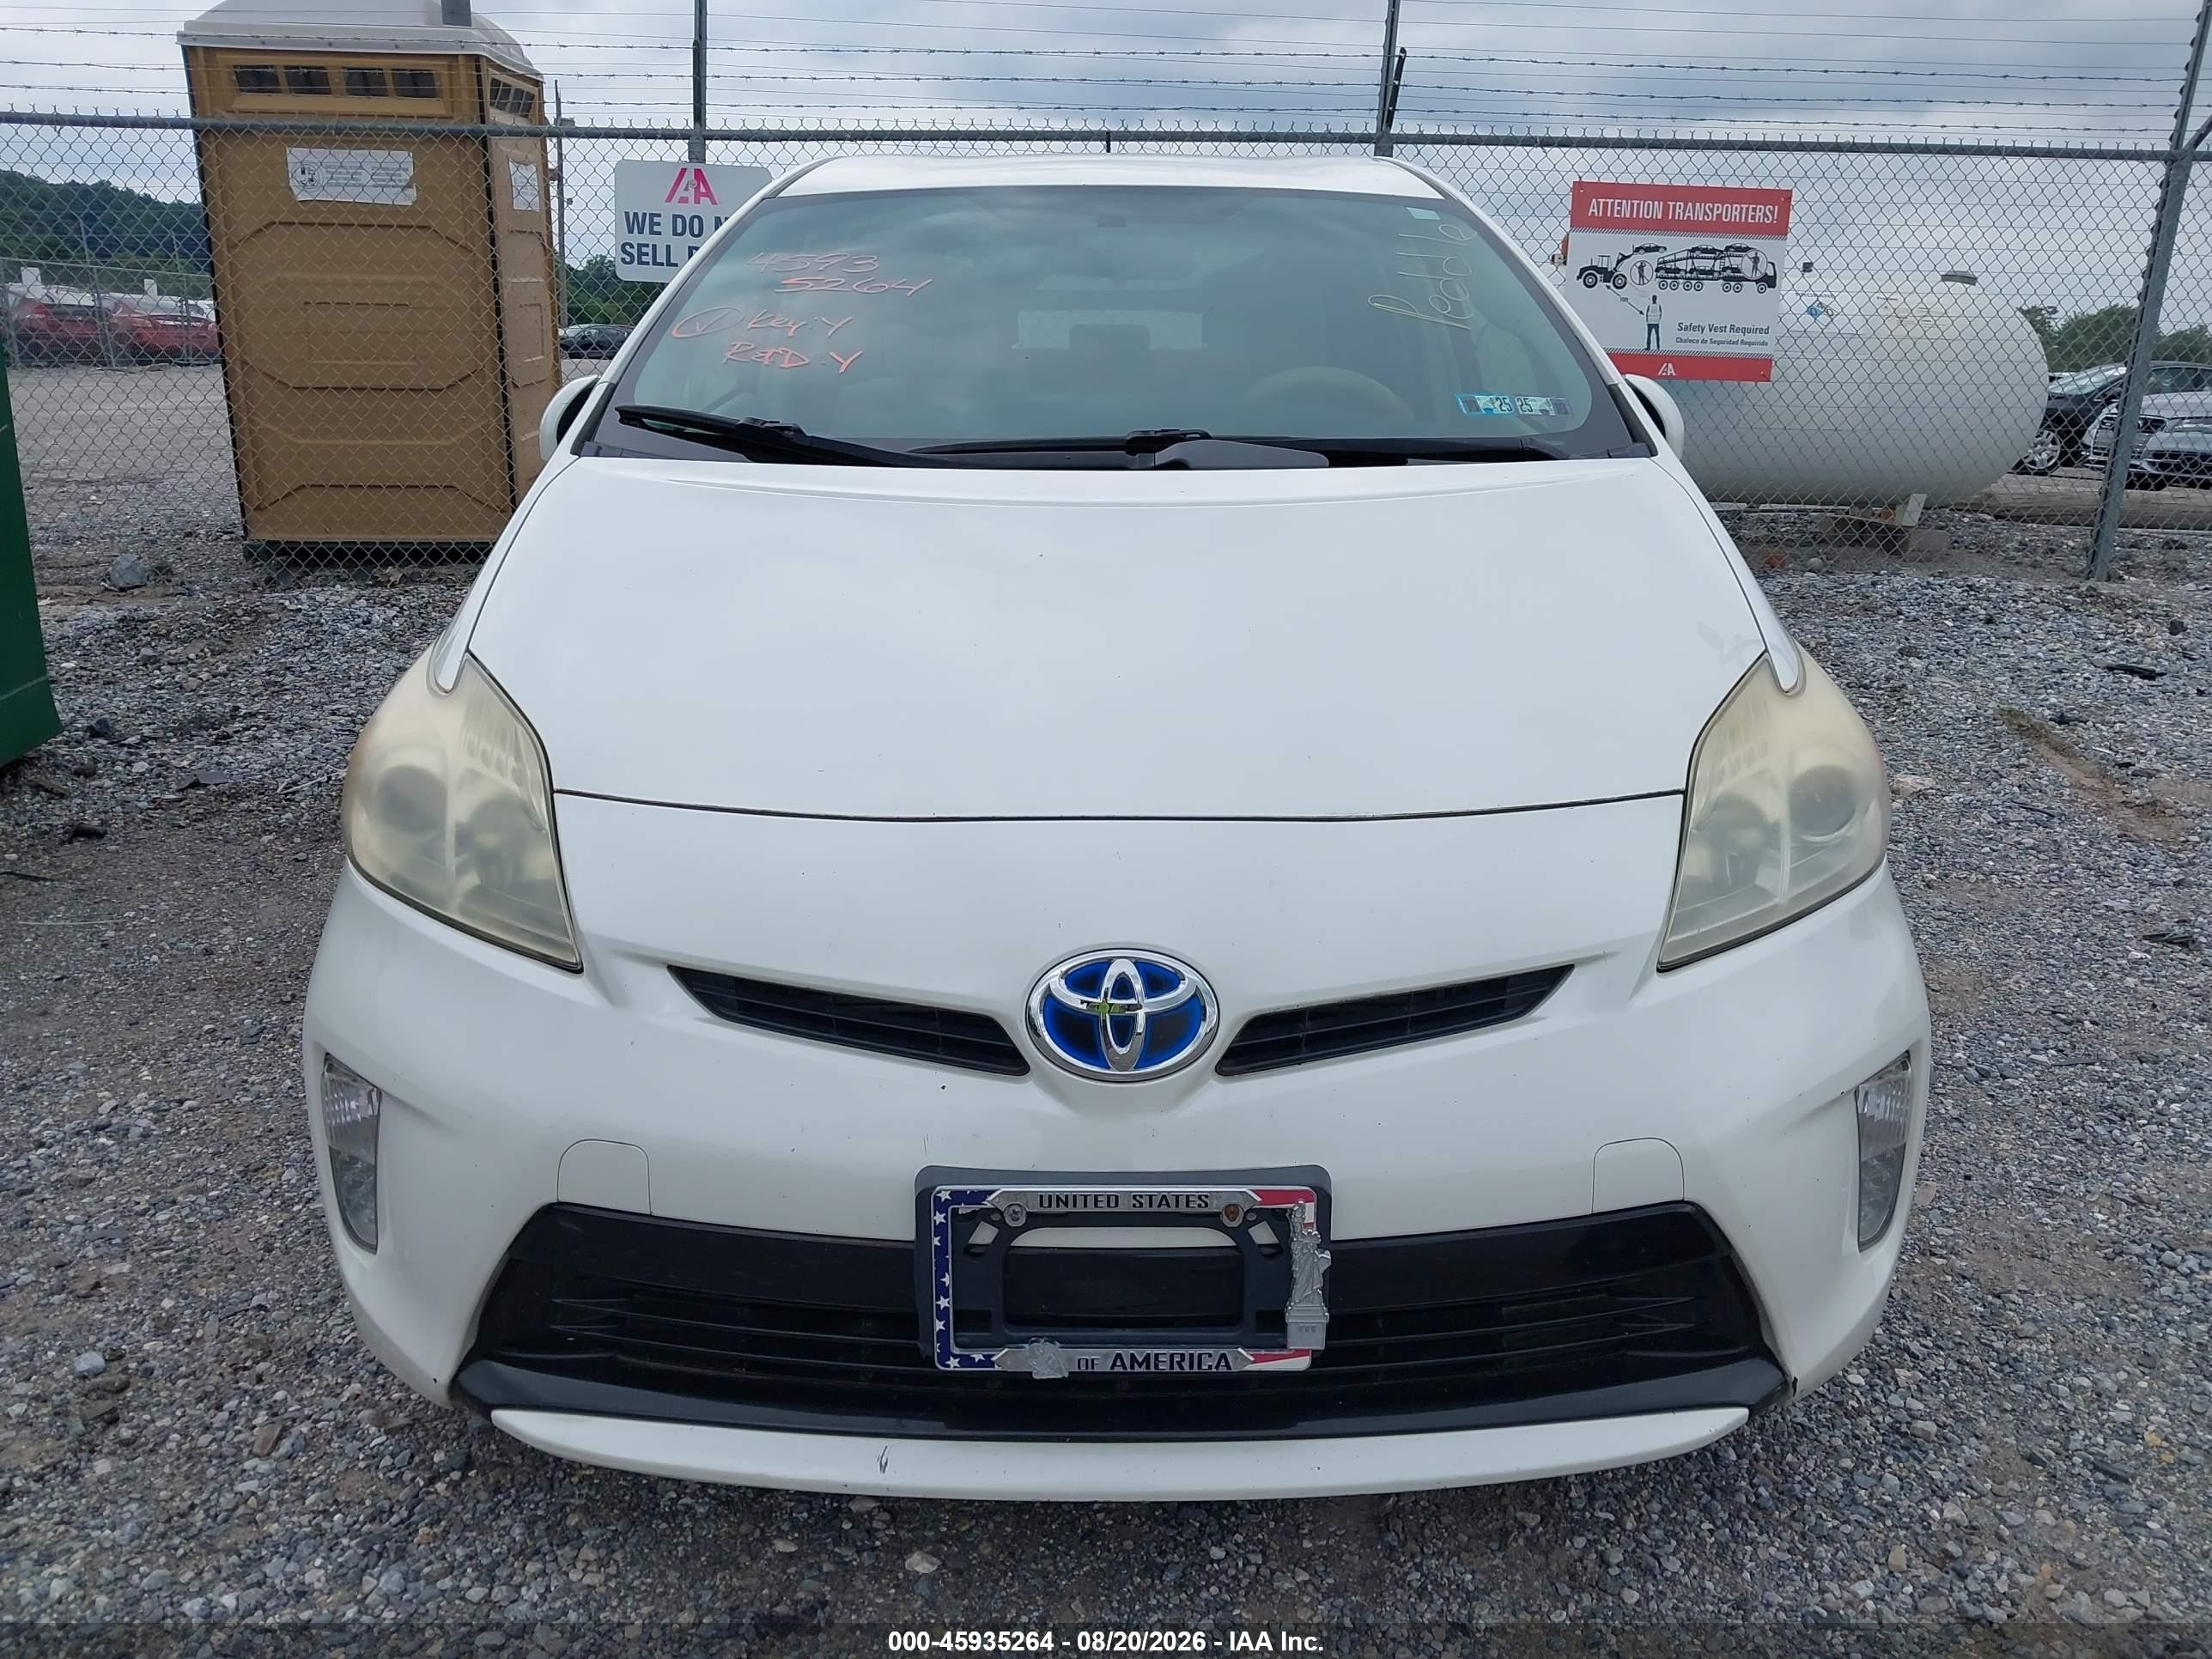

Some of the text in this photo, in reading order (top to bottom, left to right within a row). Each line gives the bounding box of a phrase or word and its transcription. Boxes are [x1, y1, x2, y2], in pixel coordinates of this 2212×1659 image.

[1588, 198, 1778, 223] ATTENTION TRANSPORTERS!
[624, 211, 662, 236] WE
[672, 214, 704, 238] DO
[620, 242, 679, 267] SELL
[745, 252, 880, 273] 4593
[775, 276, 933, 297] 5264
[1677, 321, 1770, 337] Safety Vest Required
[1709, 337, 1740, 346] Seguridad
[1495, 396, 1513, 412] 25
[1516, 397, 1534, 413] 25
[1038, 1193, 1210, 1209] UNITED STATES
[1076, 1351, 1233, 1372] OF AMERICA
